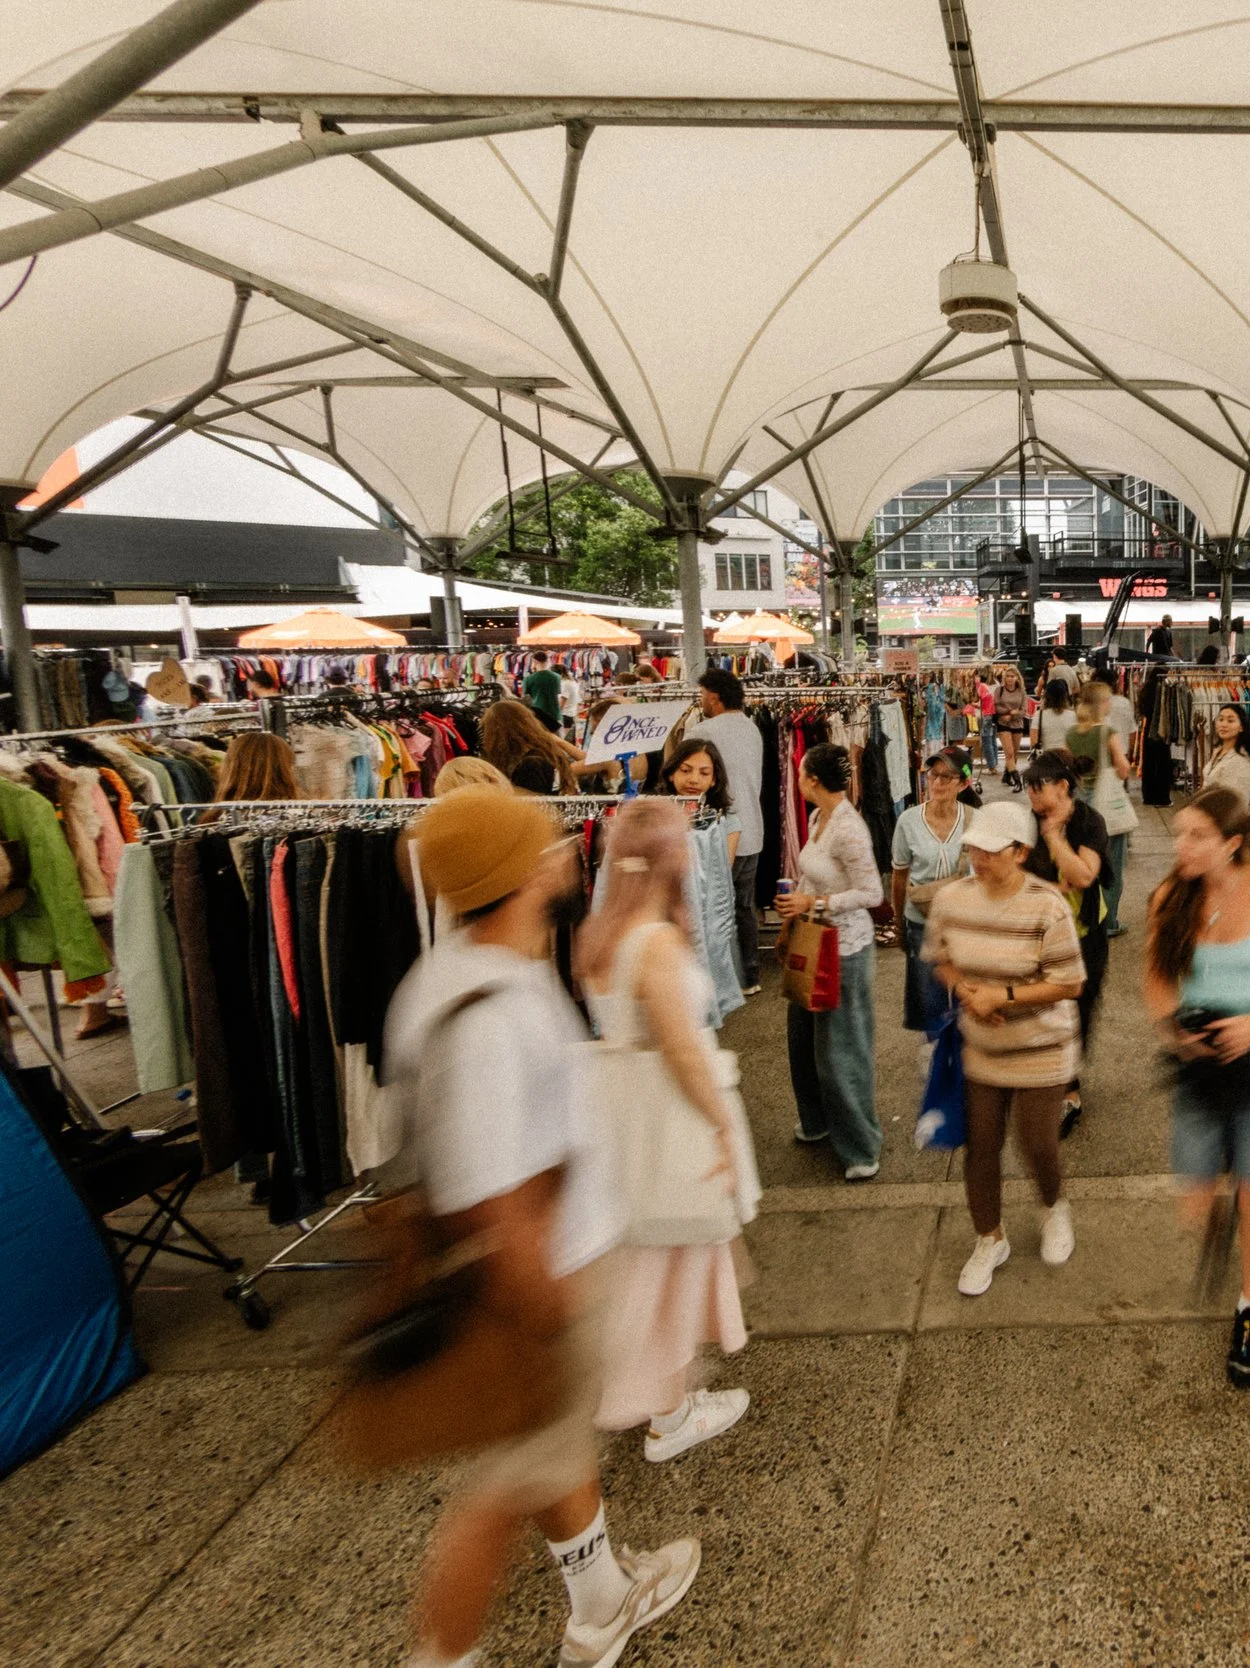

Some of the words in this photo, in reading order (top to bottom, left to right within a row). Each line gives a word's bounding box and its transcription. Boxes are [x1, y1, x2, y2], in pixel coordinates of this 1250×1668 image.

[1098, 578, 1168, 597] WNGS
[610, 715, 660, 733] ONCE
[603, 726, 668, 745] OWNED
